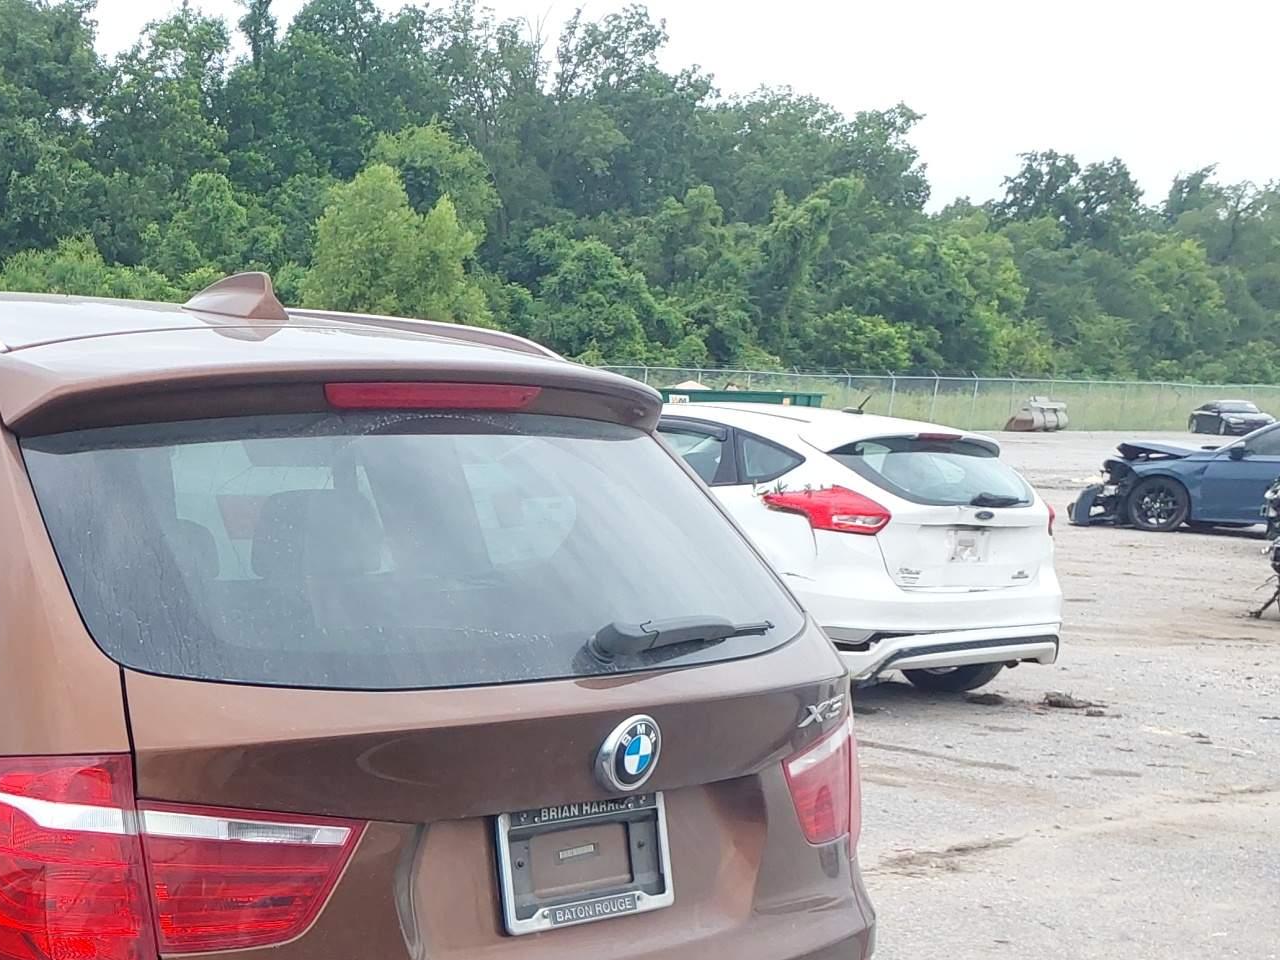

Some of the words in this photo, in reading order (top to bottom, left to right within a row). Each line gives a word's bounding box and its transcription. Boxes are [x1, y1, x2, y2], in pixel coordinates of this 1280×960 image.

[797, 693, 845, 728] X3
[621, 723, 657, 748] BMW
[540, 804, 579, 821] BRIAN
[556, 905, 594, 922] BATON
[595, 898, 633, 915] ROUGE
